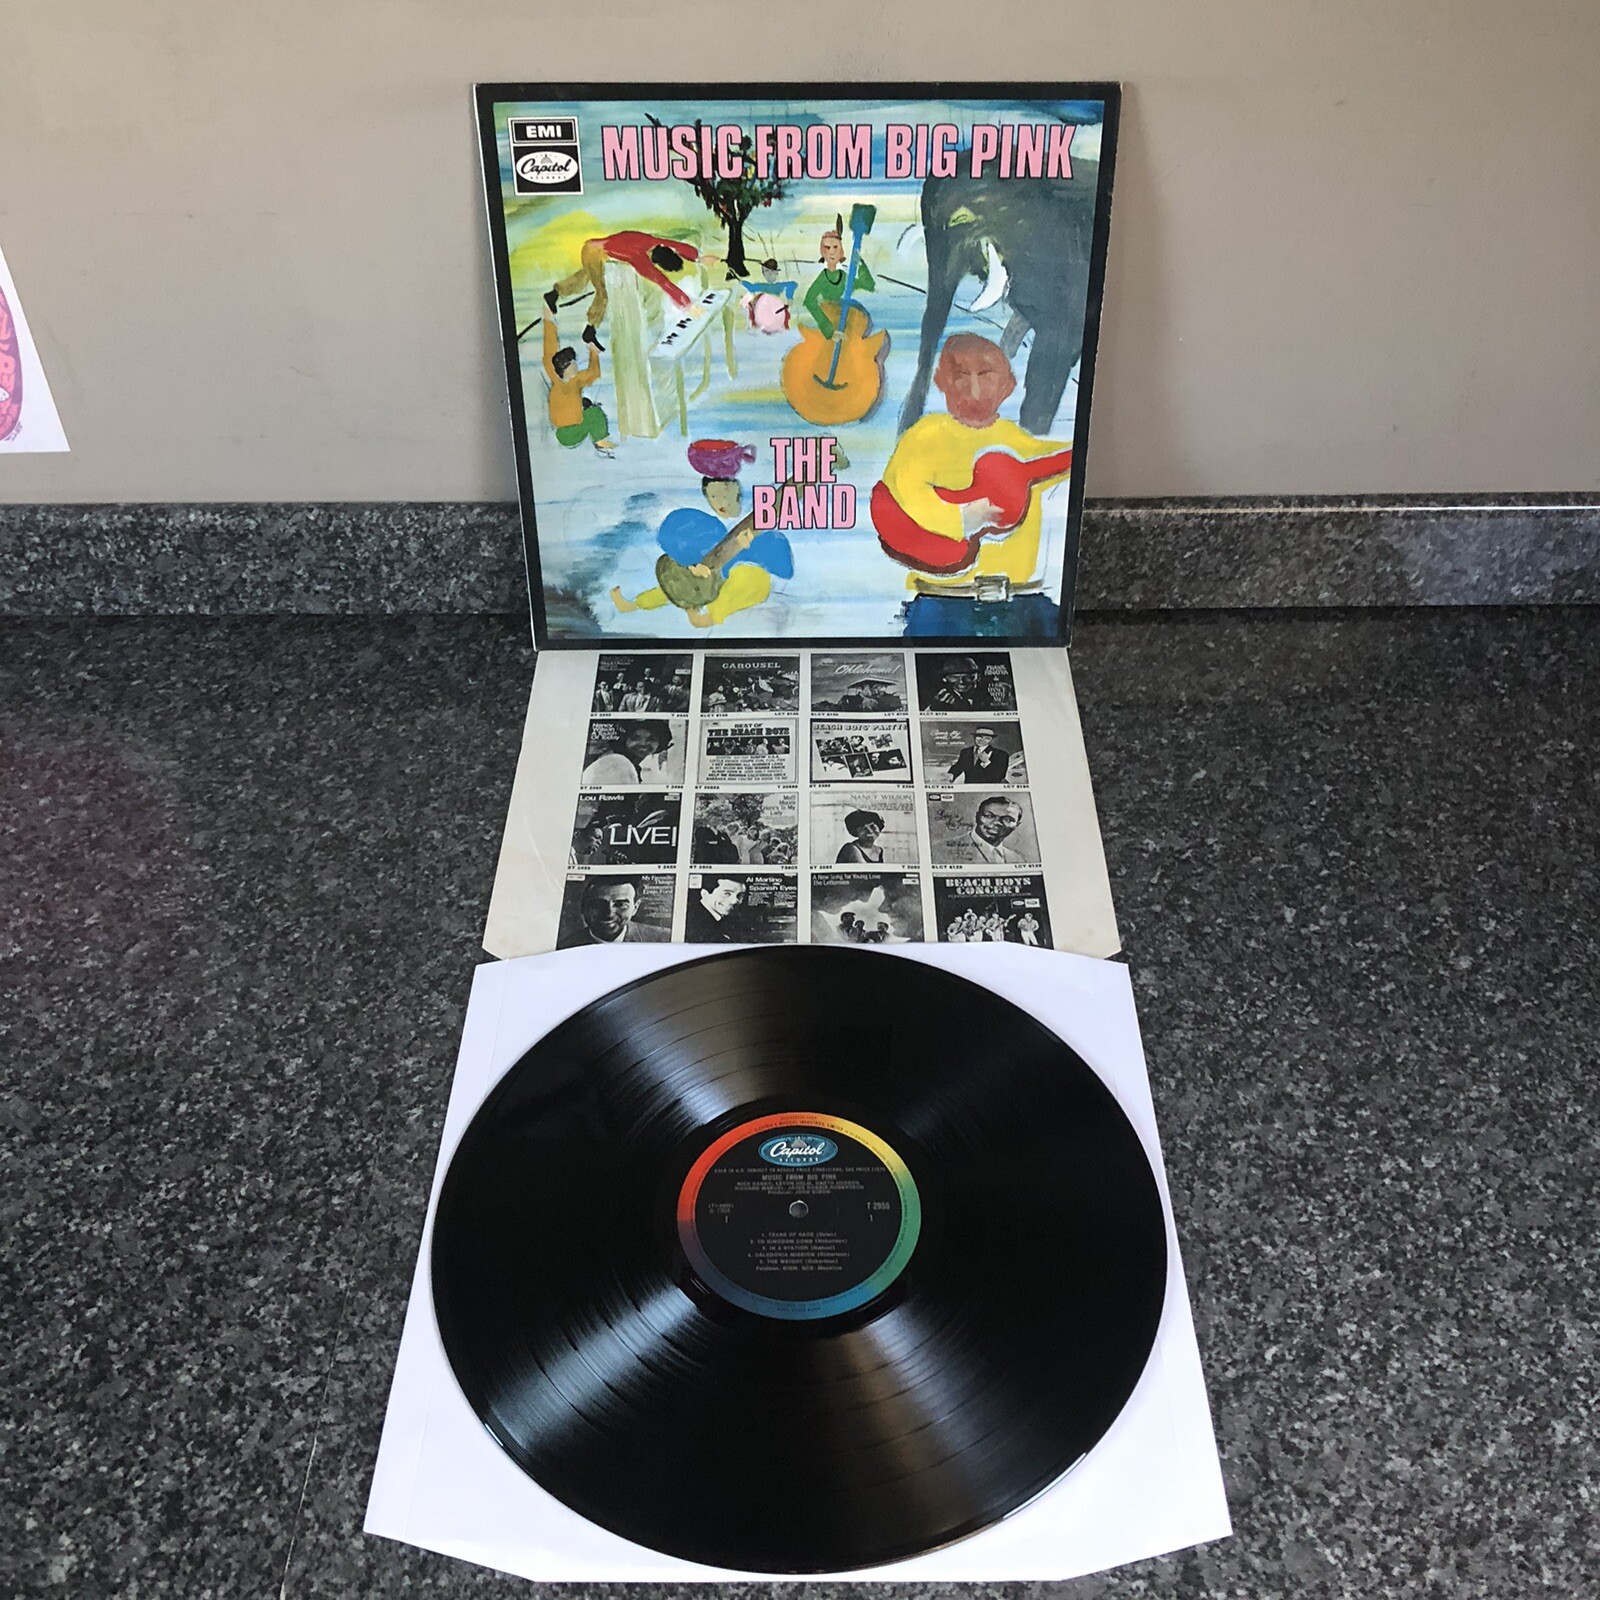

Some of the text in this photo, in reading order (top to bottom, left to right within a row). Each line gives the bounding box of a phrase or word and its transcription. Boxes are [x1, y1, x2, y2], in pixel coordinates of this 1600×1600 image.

[526, 125, 562, 138] EMI
[601, 124, 1077, 181] MUSIC FROM BIG PINK
[521, 158, 572, 175] Capitol
[769, 437, 837, 484] THE
[752, 484, 857, 530] BAND
[835, 664, 901, 675] Oklahoma!
[730, 728, 763, 736] BEACH
[945, 877, 1032, 887] BEACH BOYS
[956, 886, 1020, 895] CONCERT
[769, 1141, 826, 1158] Capitol
[867, 1202, 871, 1210] T
